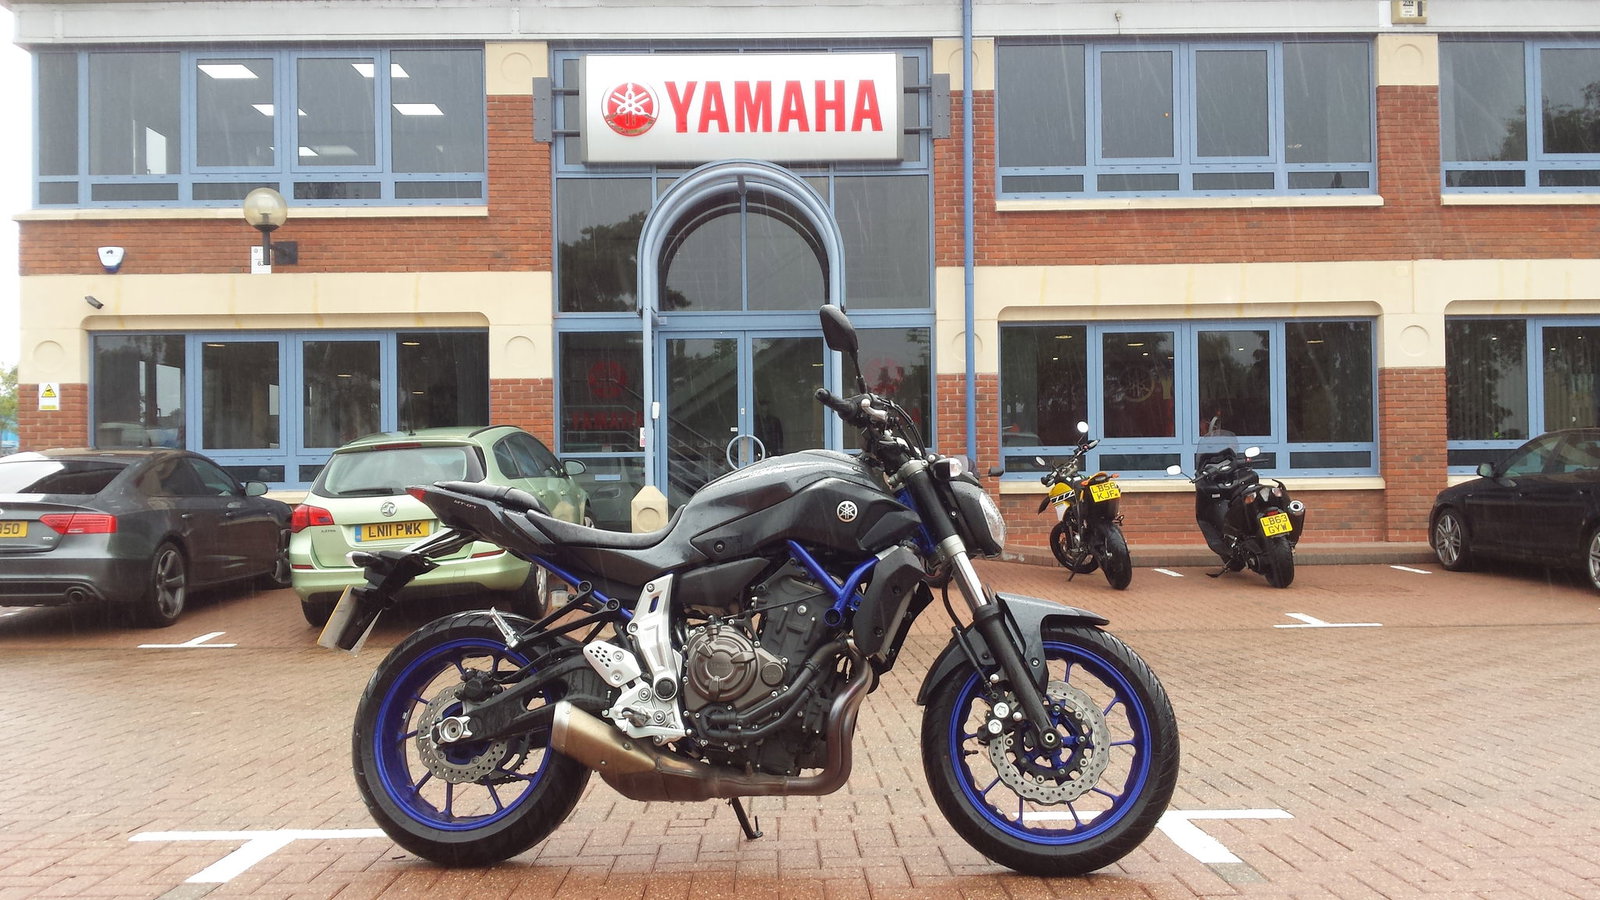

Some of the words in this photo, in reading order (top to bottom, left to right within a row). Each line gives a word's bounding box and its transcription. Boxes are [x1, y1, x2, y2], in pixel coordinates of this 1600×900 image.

[664, 79, 883, 133] YAMAHA
[1097, 490, 1115, 500] KJF
[1262, 514, 1288, 527] LB63
[368, 524, 392, 538] LN11
[396, 522, 422, 536] PWK
[1268, 523, 1288, 534] GYW
